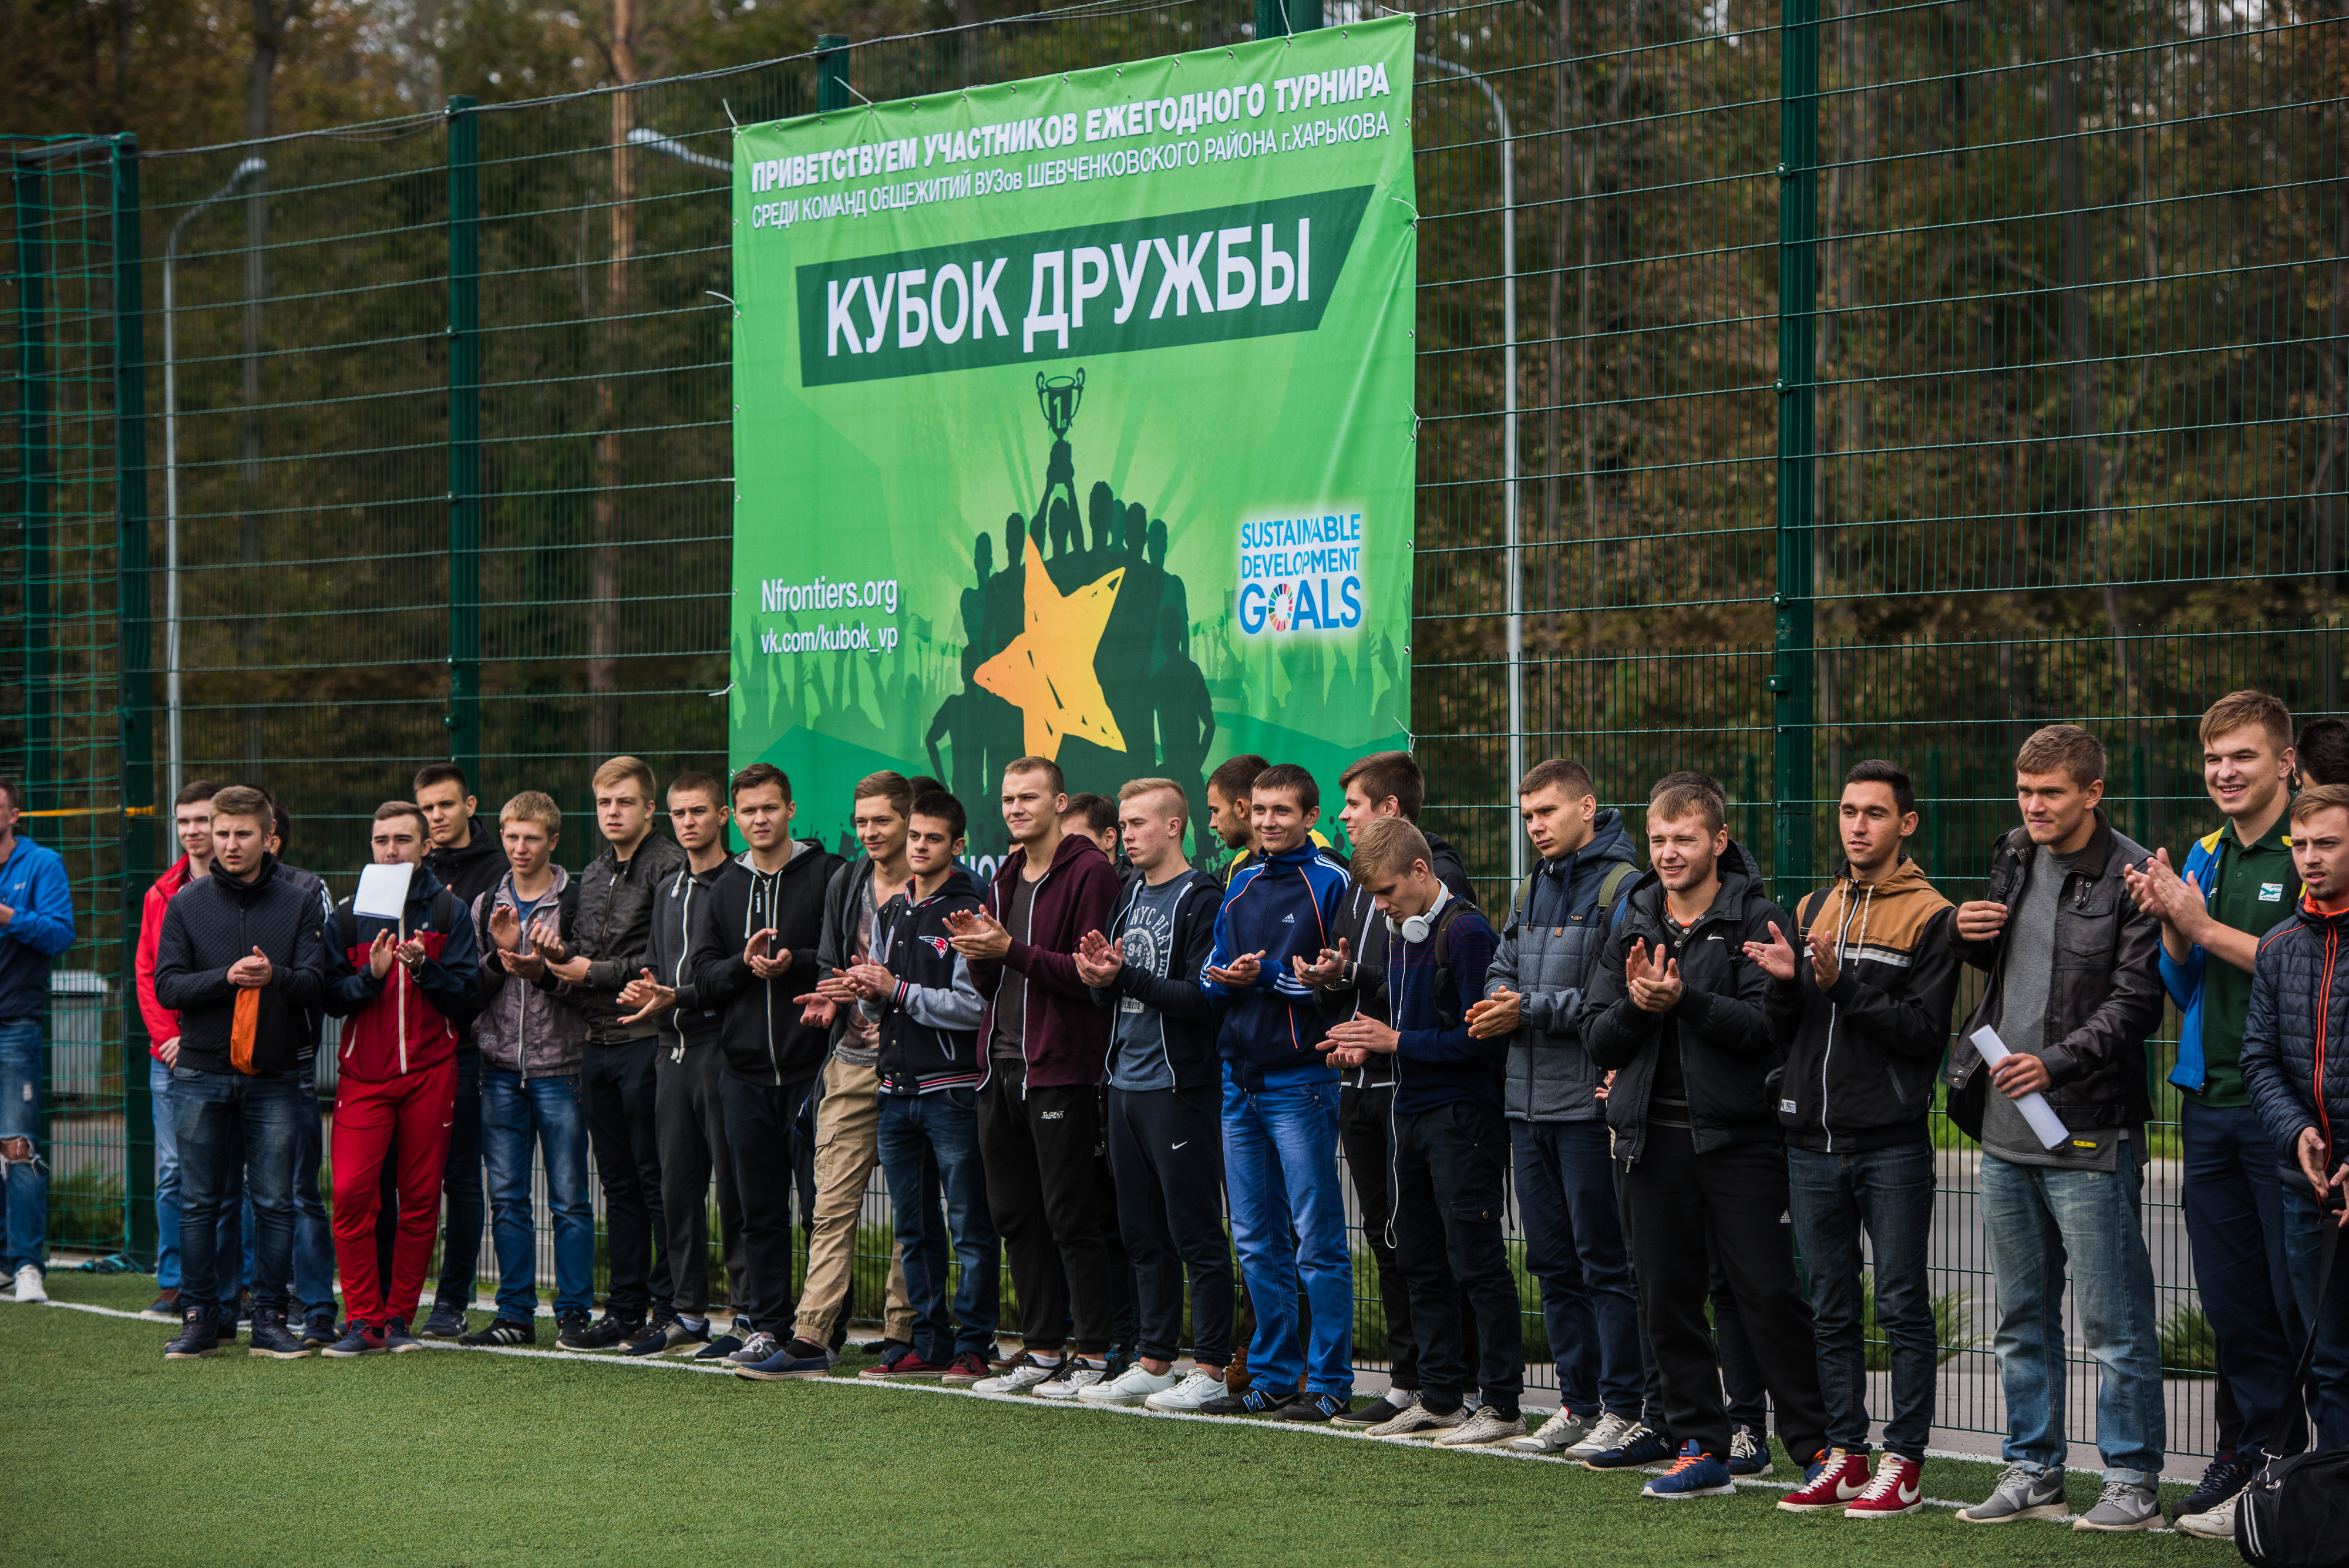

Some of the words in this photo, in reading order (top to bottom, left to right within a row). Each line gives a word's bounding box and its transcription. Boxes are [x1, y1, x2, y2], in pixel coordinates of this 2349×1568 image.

[752, 137, 918, 193] ПРИВЕТСТВУЕМ
[923, 112, 1079, 167] УЧАСТНИКОВ
[1085, 82, 1266, 143] ЕЖЕГОДНОГО
[1273, 61, 1391, 113] ТУРНИРА
[752, 199, 799, 230] СРЕДИ
[802, 189, 867, 219] КОМАНД
[869, 169, 972, 212] ОБЩЕЖИТИЙ
[975, 168, 1024, 196] ВУЗов
[1027, 140, 1201, 189] ШЕВЧЕНКОВСКОГО
[1204, 128, 1278, 163] РАЙОНА
[828, 257, 1010, 357] КУБОК
[1023, 217, 1311, 354] ДРУЖБЫ
[1241, 514, 1361, 549] SUSTAINABLE
[1241, 547, 1360, 579] DEVELOPMENT
[762, 575, 898, 614] Nfrontiers.org
[1239, 576, 1361, 634] GOALS
[760, 622, 898, 654] vk.com/kubok_vp
[1129, 906, 1156, 926] NYC
[1124, 934, 1137, 944] NEW
[1126, 943, 1143, 958] 94
